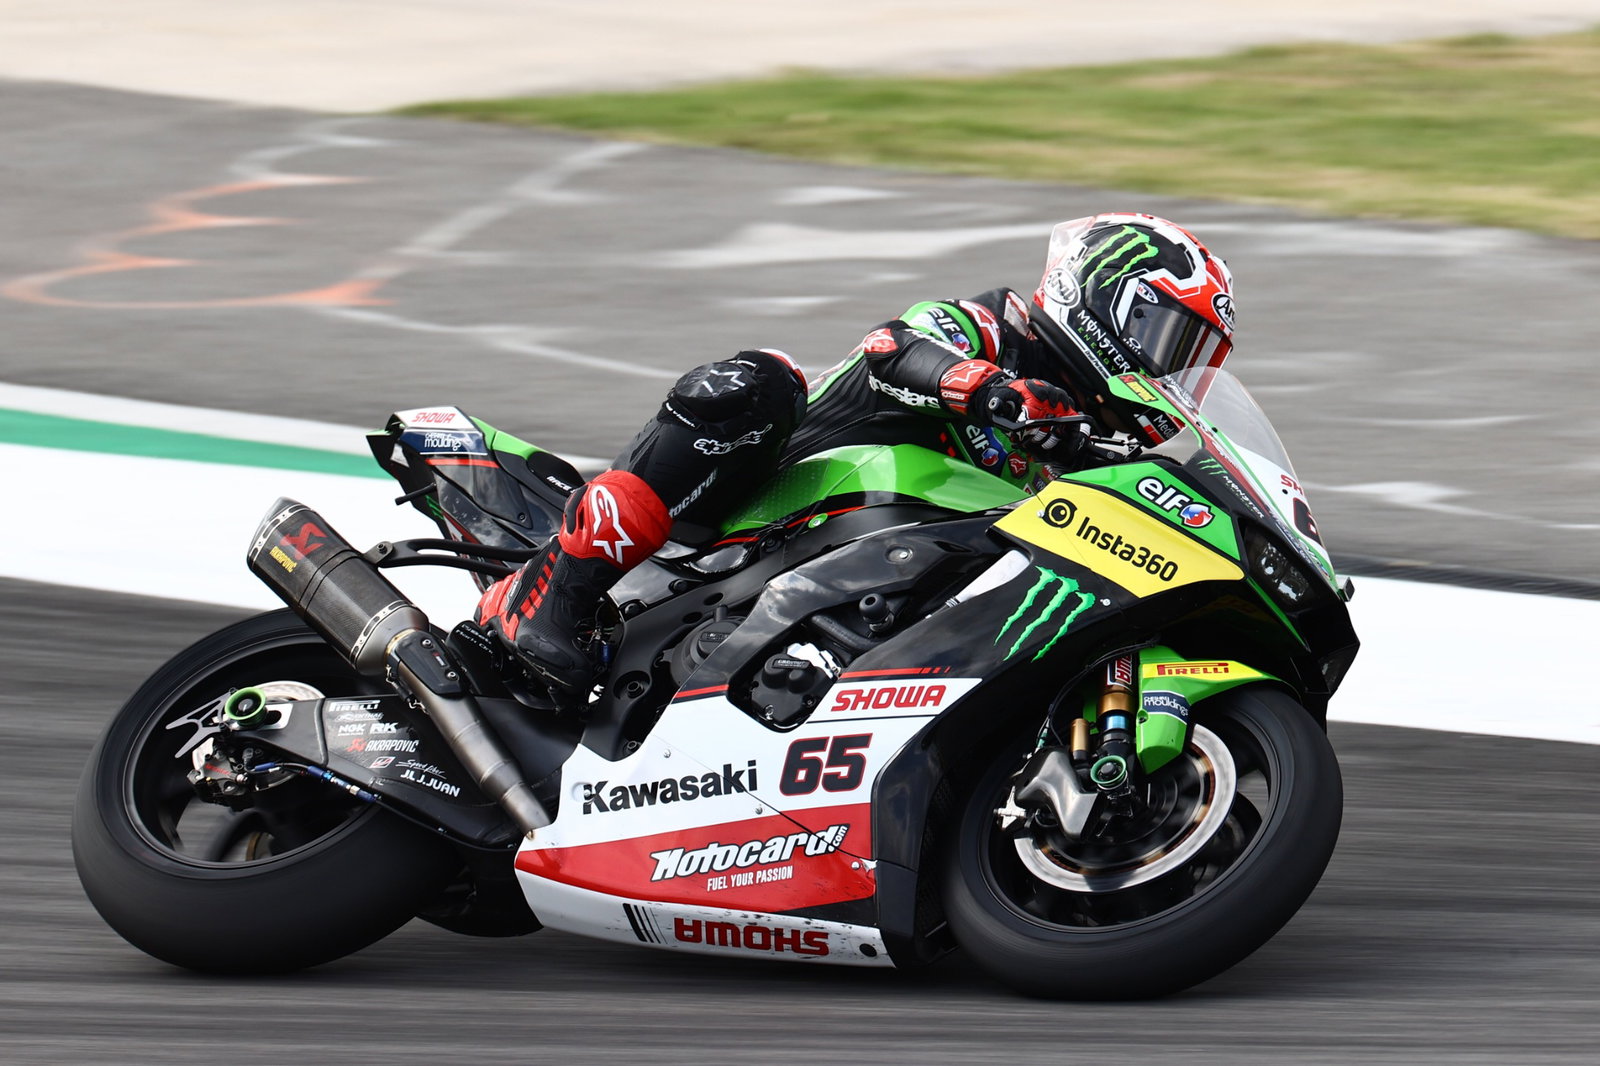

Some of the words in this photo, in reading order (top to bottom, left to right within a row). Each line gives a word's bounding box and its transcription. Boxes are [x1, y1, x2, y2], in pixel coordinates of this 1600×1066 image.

[1077, 310, 1131, 374] MONSTER
[1077, 326, 1116, 371] ENERGY
[411, 412, 456, 423] SHOWA
[1136, 476, 1189, 512] elf
[1075, 516, 1180, 582] Insta360
[1157, 662, 1230, 676] PIRELLI
[328, 700, 381, 712] PIRELLI
[830, 684, 947, 713] SHOWA
[339, 719, 367, 733] NGK
[370, 717, 398, 734] RK
[779, 732, 873, 797] 65
[582, 760, 758, 815] Kawasaki
[707, 875, 728, 892] FUEL
[730, 872, 753, 888] YOUR
[756, 865, 793, 884] PASSION
[673, 916, 830, 956] SHOWA
